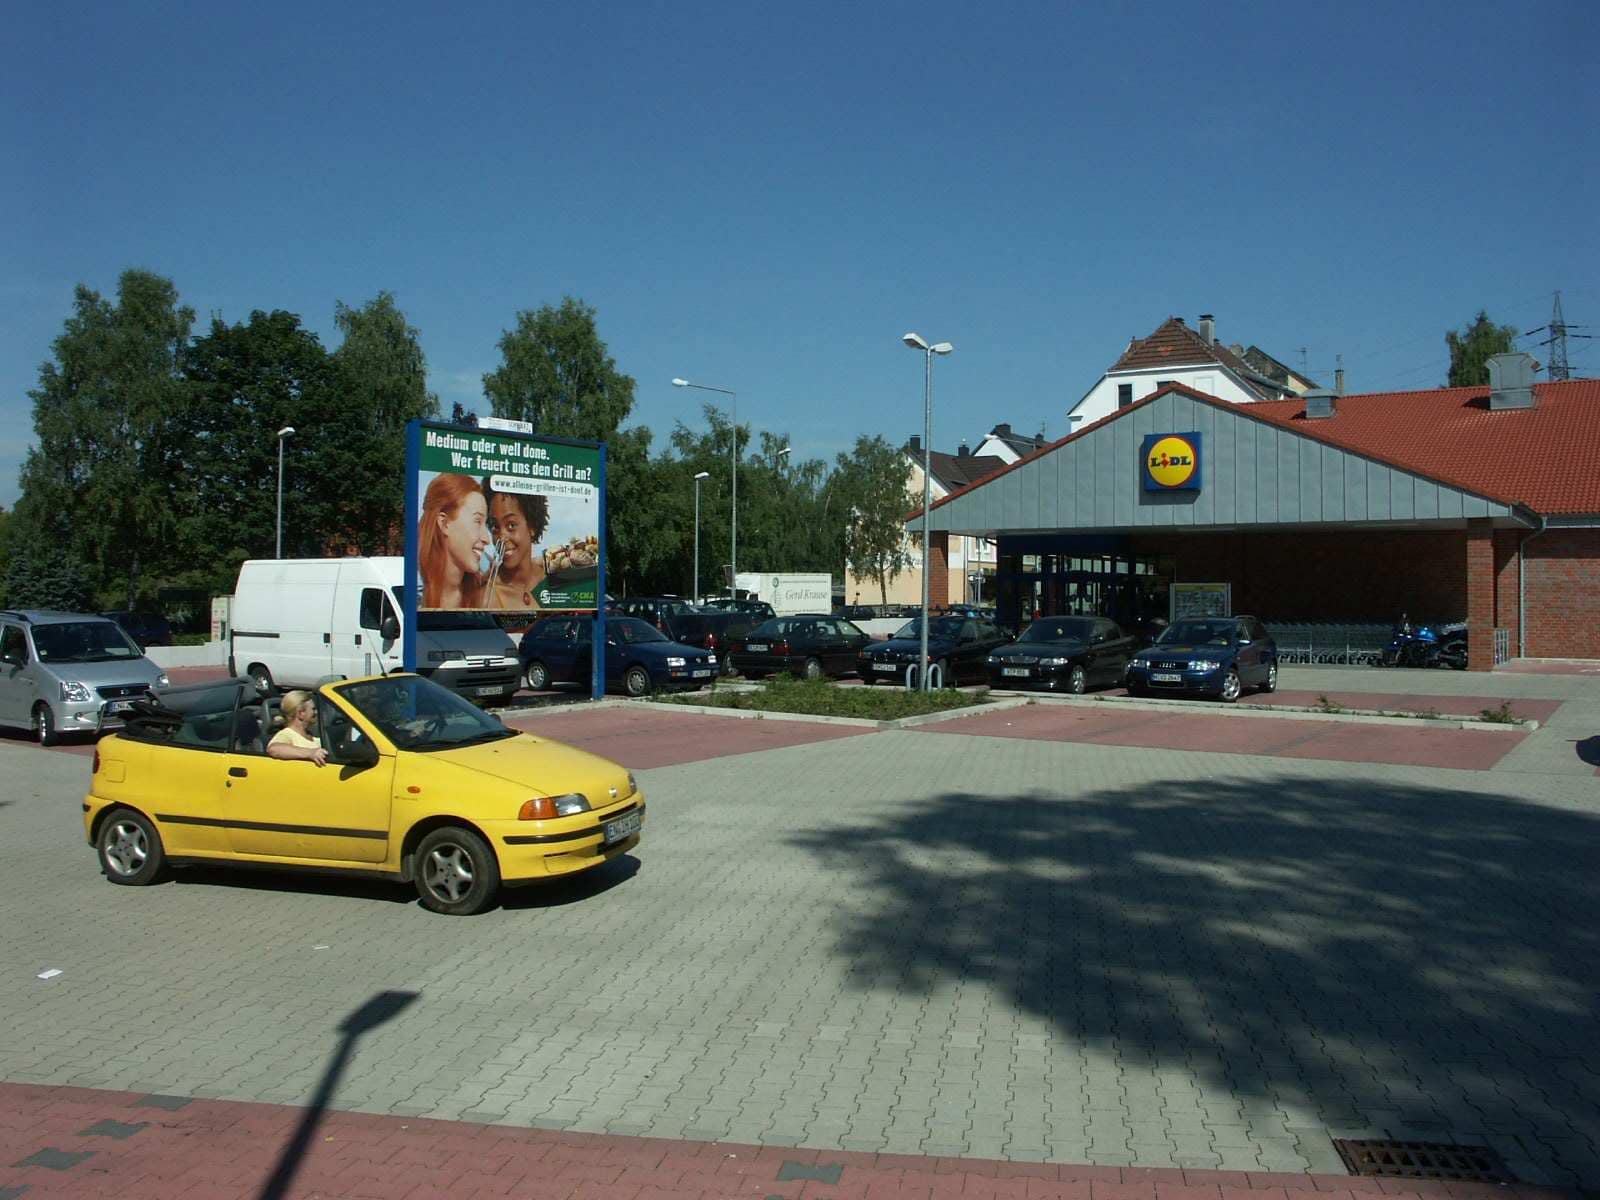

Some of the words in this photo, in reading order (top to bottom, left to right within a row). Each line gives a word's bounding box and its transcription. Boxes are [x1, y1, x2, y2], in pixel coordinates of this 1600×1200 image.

[426, 431, 469, 451] Medium
[472, 438, 496, 454] oder
[499, 442, 521, 457] well
[523, 443, 550, 460] done.
[451, 451, 473, 468] Wer
[476, 455, 510, 473] feuert
[512, 462, 530, 475] uns
[532, 461, 551, 477] den
[552, 463, 573, 479] Grill
[575, 467, 592, 481] an?
[804, 589, 828, 600] Krause
